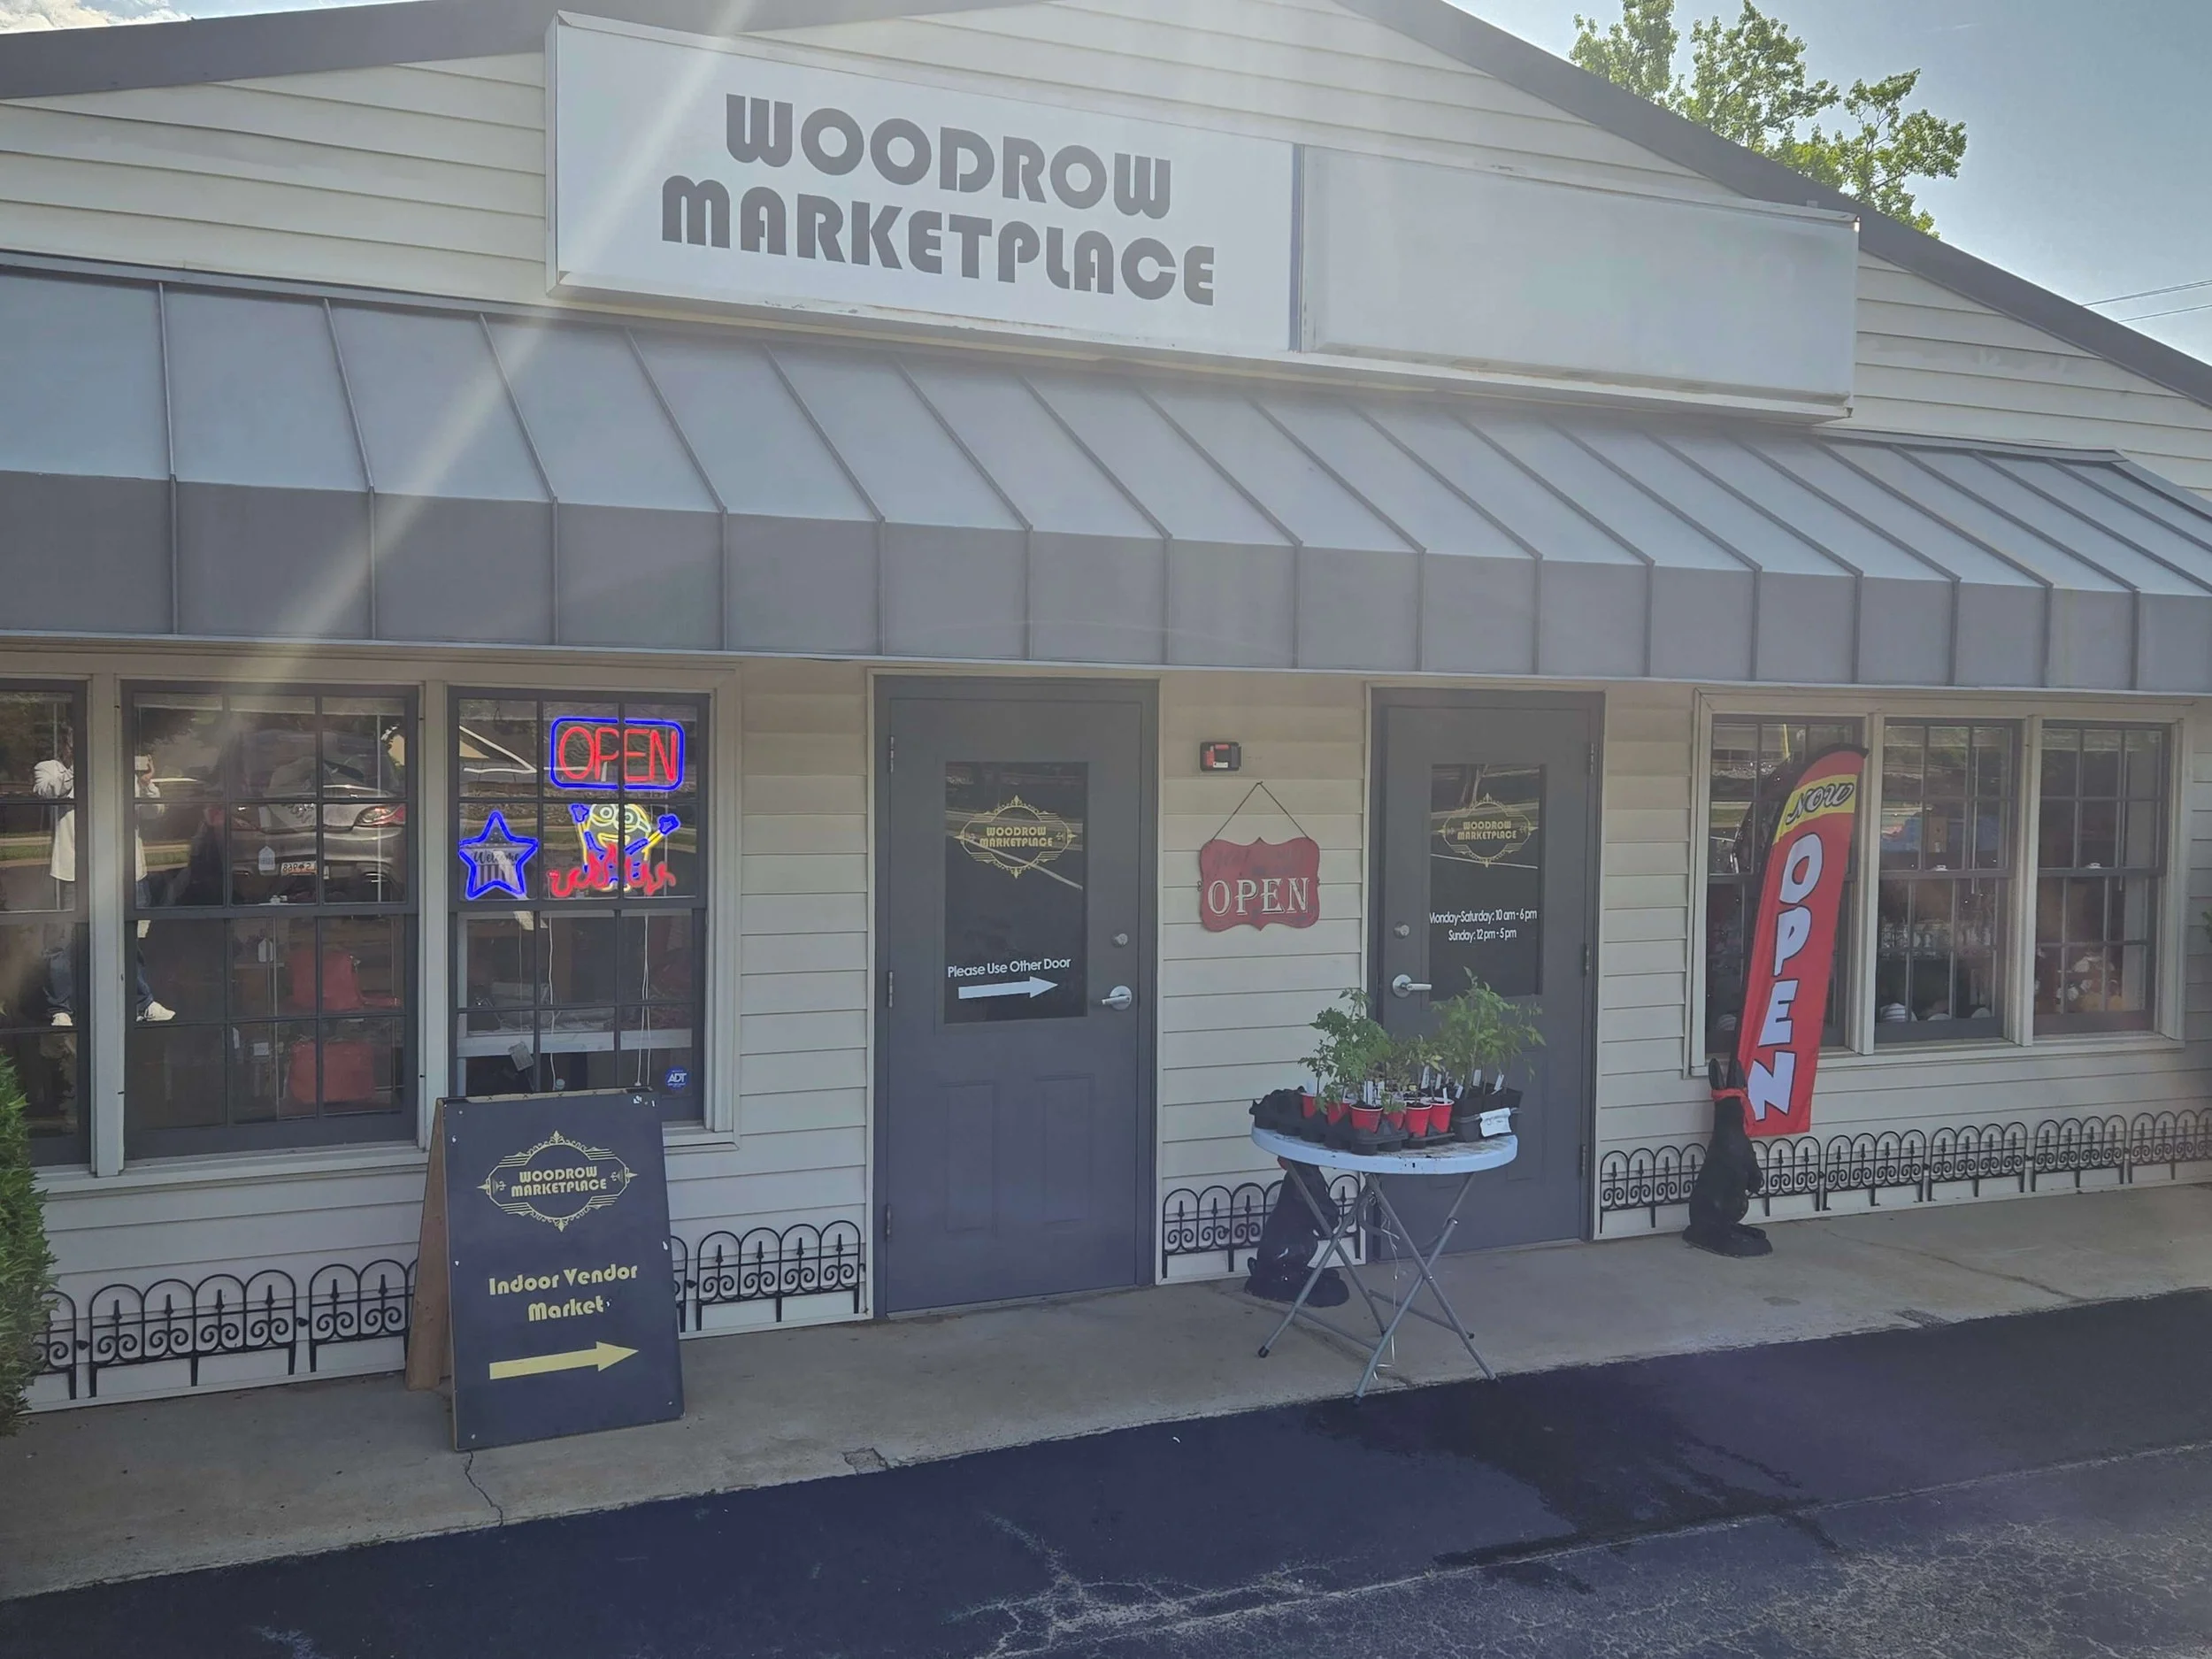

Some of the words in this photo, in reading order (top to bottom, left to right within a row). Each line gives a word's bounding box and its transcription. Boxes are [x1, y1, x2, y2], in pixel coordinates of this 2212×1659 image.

[726, 93, 1171, 220] WOODROW
[661, 174, 1215, 306] MARKETPLACE
[557, 726, 678, 781] OPEN
[1785, 781, 1855, 826] NOW
[986, 826, 1047, 837] WOODROW
[1463, 820, 1511, 830] WOODROW
[979, 837, 1053, 848] MARKETPLACE
[1456, 830, 1517, 841] MARKETPLACE
[1208, 877, 1310, 916] OPEN
[1495, 909, 1503, 921] 10
[1504, 911, 1516, 921] am
[1519, 908, 1525, 920] 6
[1525, 910, 1538, 923] pm
[1448, 929, 1476, 944] Sunday:
[1476, 928, 1484, 940] 12
[1484, 930, 1496, 942] pm
[1499, 927, 1505, 939] 5
[1504, 929, 1517, 941] pm
[947, 964, 986, 978] Please
[987, 962, 1008, 974] Use
[1010, 960, 1042, 972] Other
[1043, 957, 1071, 970] Door
[1747, 832, 1824, 1122] OPEN
[667, 1072, 687, 1083] ADT
[518, 1165, 598, 1184] WOODROW
[511, 1178, 608, 1197] MARKETPLACE
[488, 1273, 559, 1295] Indoor
[563, 1263, 638, 1287] Vendor
[528, 1295, 604, 1322] Market
